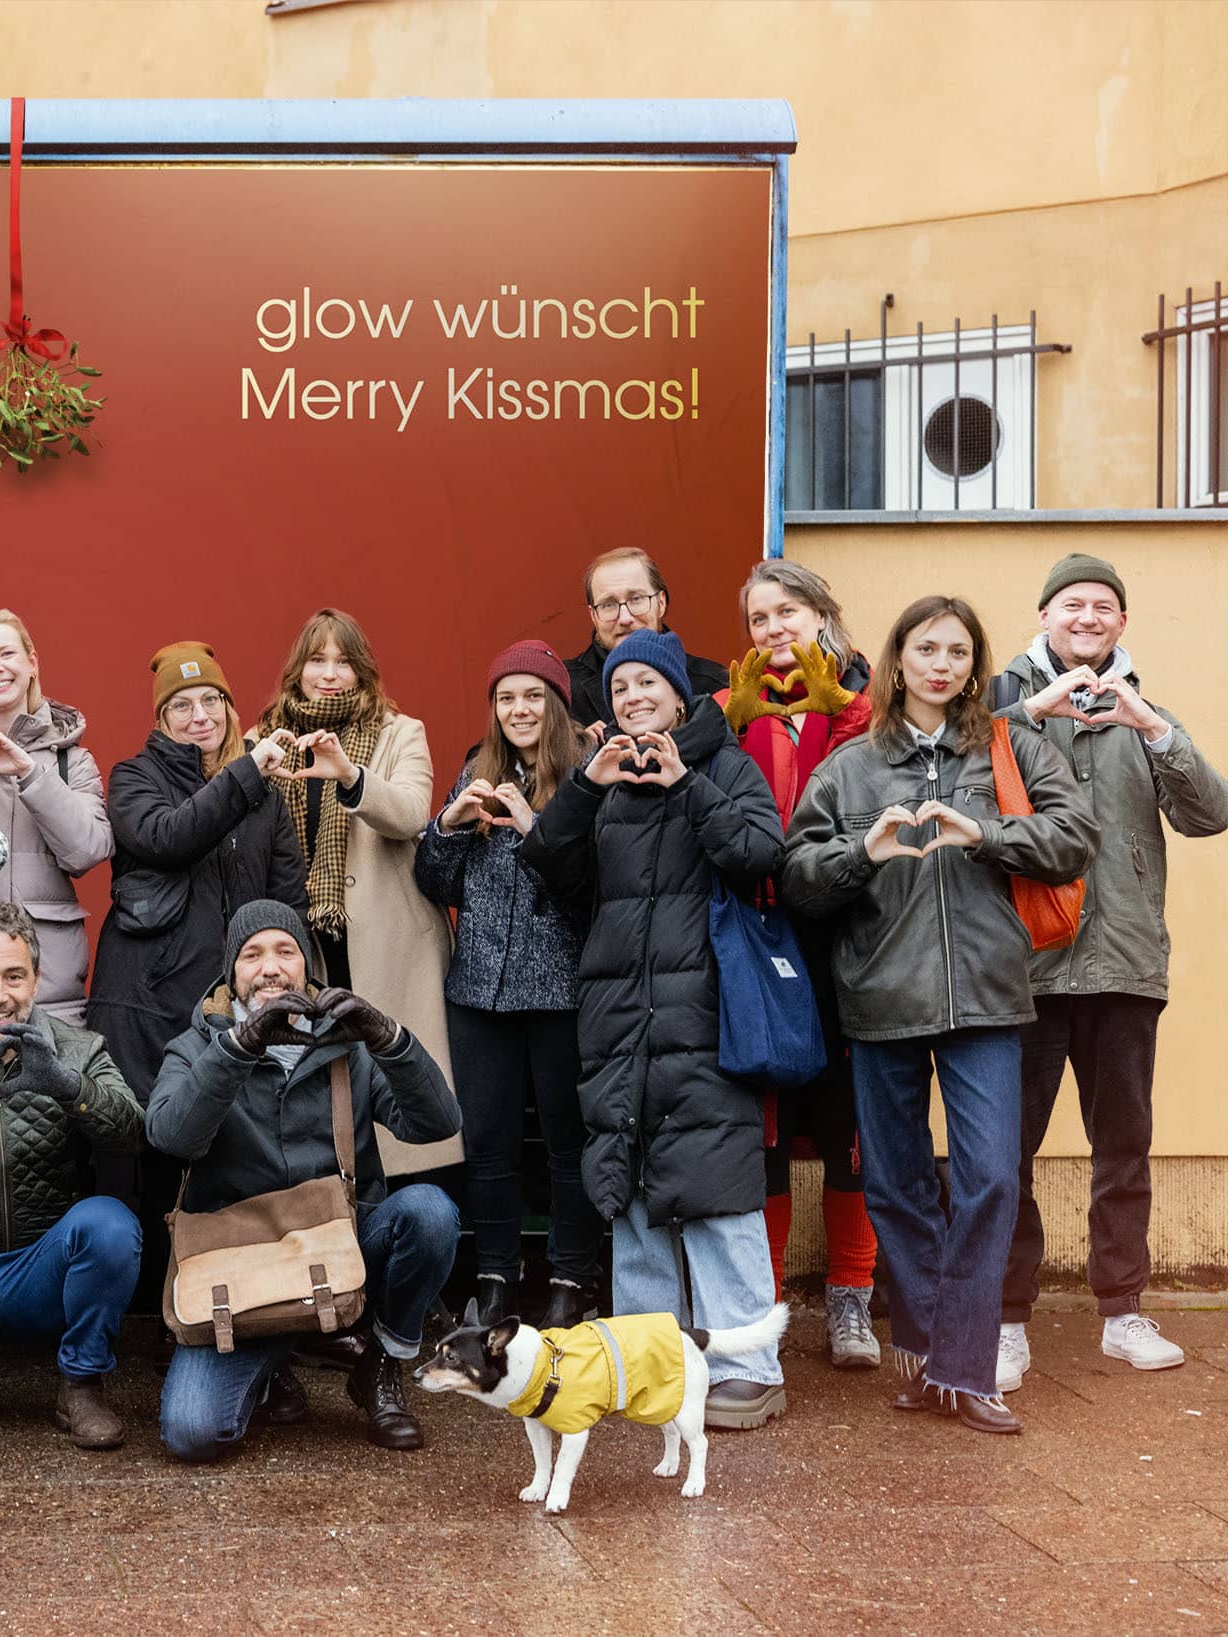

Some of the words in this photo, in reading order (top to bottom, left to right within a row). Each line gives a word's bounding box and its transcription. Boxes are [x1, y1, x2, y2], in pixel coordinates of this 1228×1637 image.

[256, 286, 414, 352] glow
[432, 284, 705, 339] wünscht
[241, 367, 425, 432] Merry
[447, 367, 699, 420] Kissmas!
